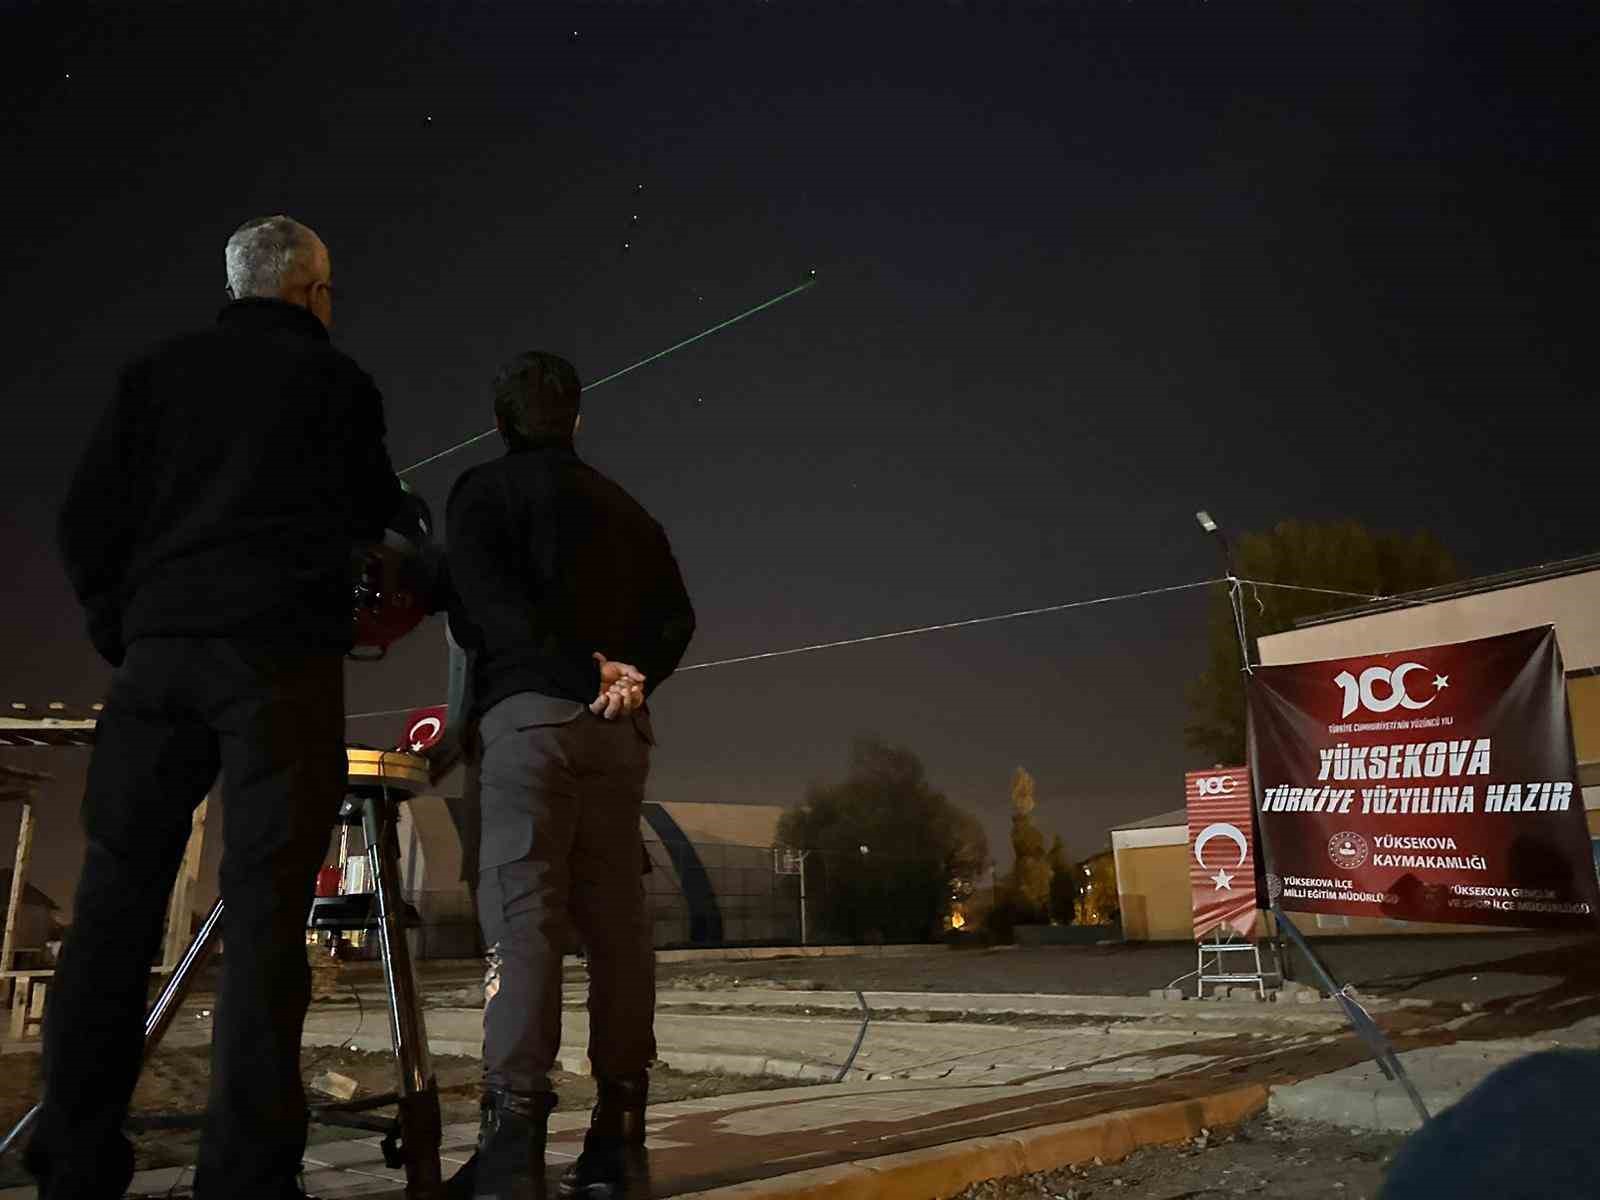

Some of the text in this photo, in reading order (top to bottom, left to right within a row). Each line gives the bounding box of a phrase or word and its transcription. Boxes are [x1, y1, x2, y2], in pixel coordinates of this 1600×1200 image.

[1317, 738, 1491, 781] YÜKSEKOVA
[1261, 782, 1573, 814] TÜRKİYE YÜZYILINA HAZIR
[1373, 834, 1457, 850] YÜKSEKOVA
[1373, 853, 1488, 871] KAYMAKAMLIĞI
[1283, 876, 1353, 889] YÜKSEKOVA İLÇE
[1283, 888, 1306, 898] MİLLİ
[1307, 889, 1337, 900] EĞİTİM
